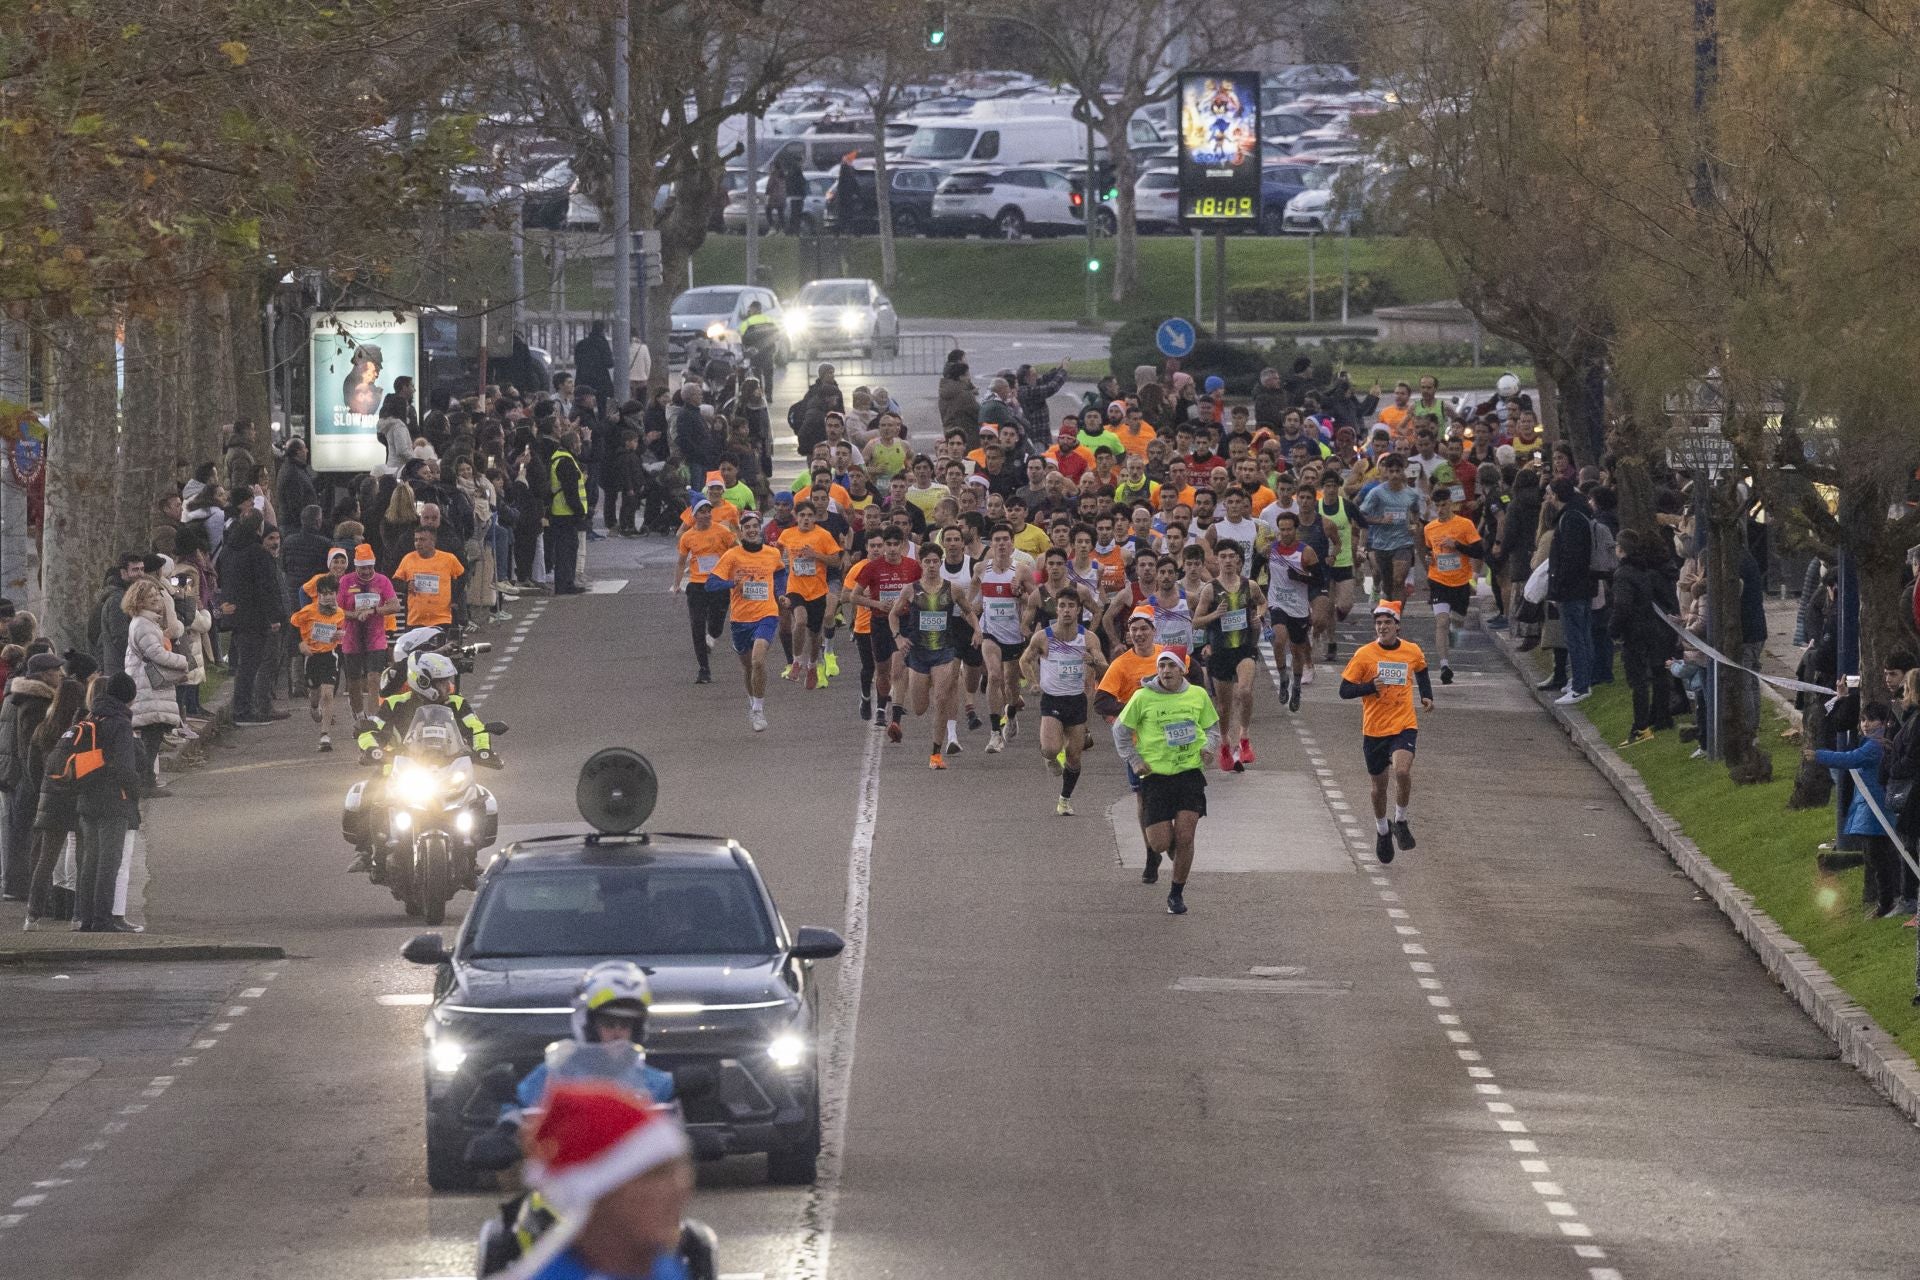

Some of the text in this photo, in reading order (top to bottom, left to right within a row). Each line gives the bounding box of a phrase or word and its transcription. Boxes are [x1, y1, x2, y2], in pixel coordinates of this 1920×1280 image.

[1195, 198, 1252, 216] 18:09
[354, 320, 398, 329] Movistar
[333, 413, 361, 427] SLOW
[995, 608, 1005, 616] 14
[921, 617, 942, 625] 2550
[1062, 666, 1079, 674] 215
[1379, 669, 1402, 678] 4890
[1168, 728, 1189, 739] 1931
